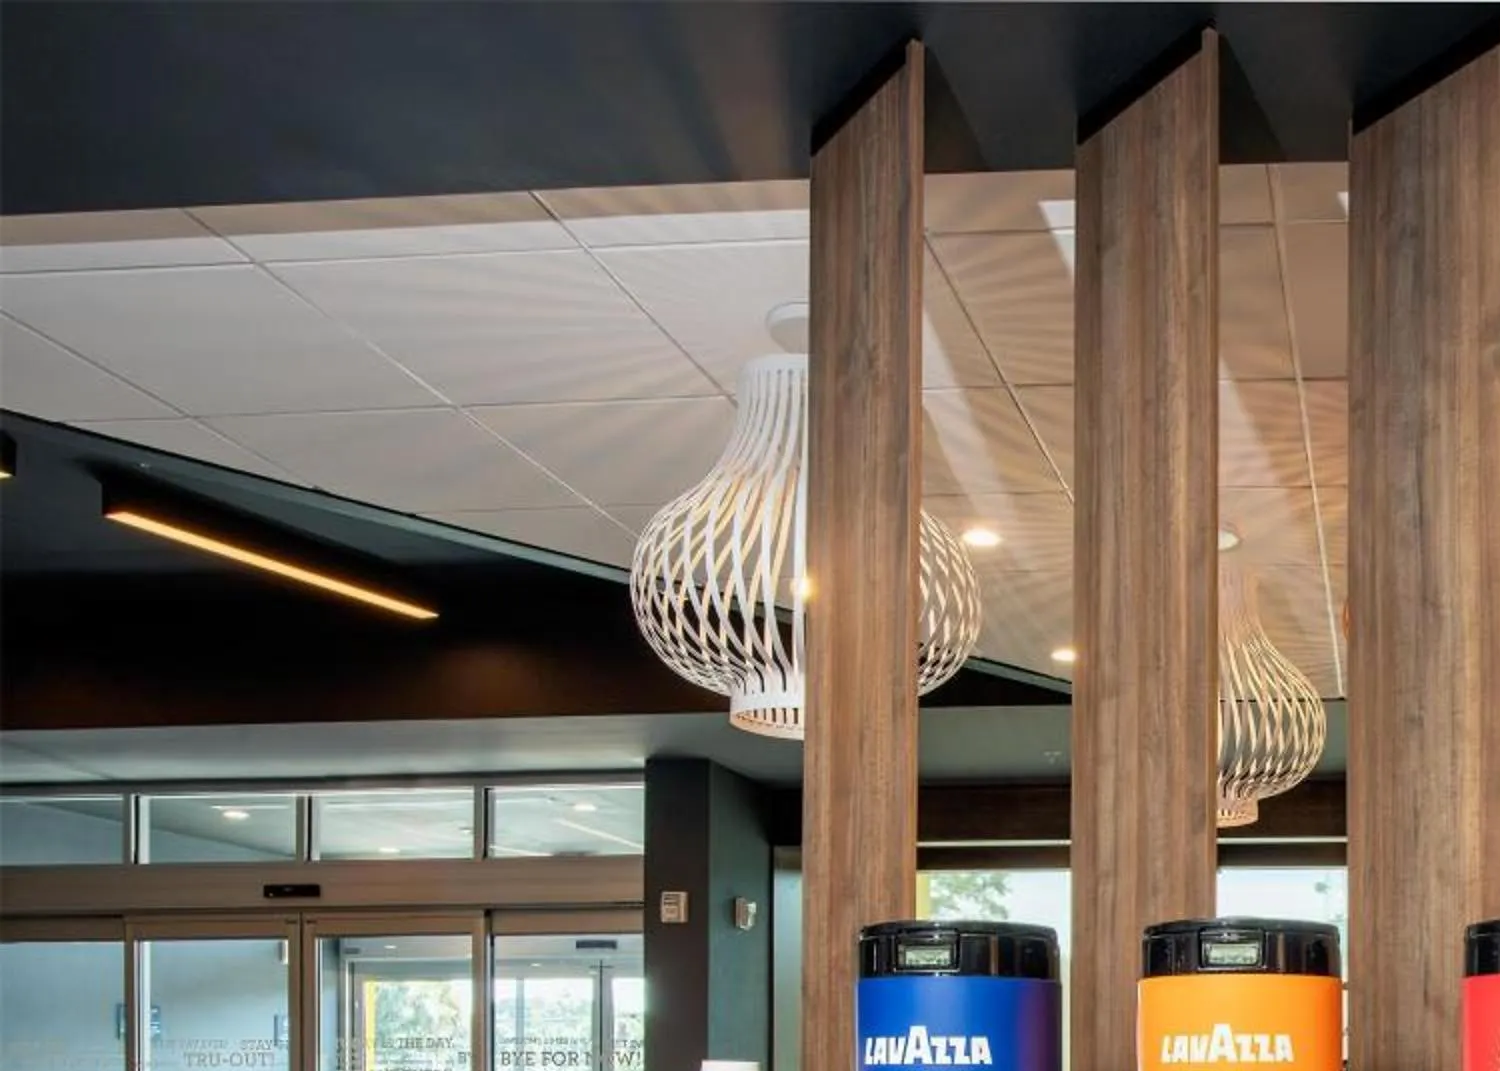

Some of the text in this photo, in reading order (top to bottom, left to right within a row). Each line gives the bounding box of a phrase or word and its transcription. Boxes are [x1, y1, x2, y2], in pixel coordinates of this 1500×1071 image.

[500, 1051, 642, 1067] BYE FOR NW!
[864, 1025, 993, 1065] LAVAZZA
[1160, 1023, 1294, 1063] LAVAZZA
